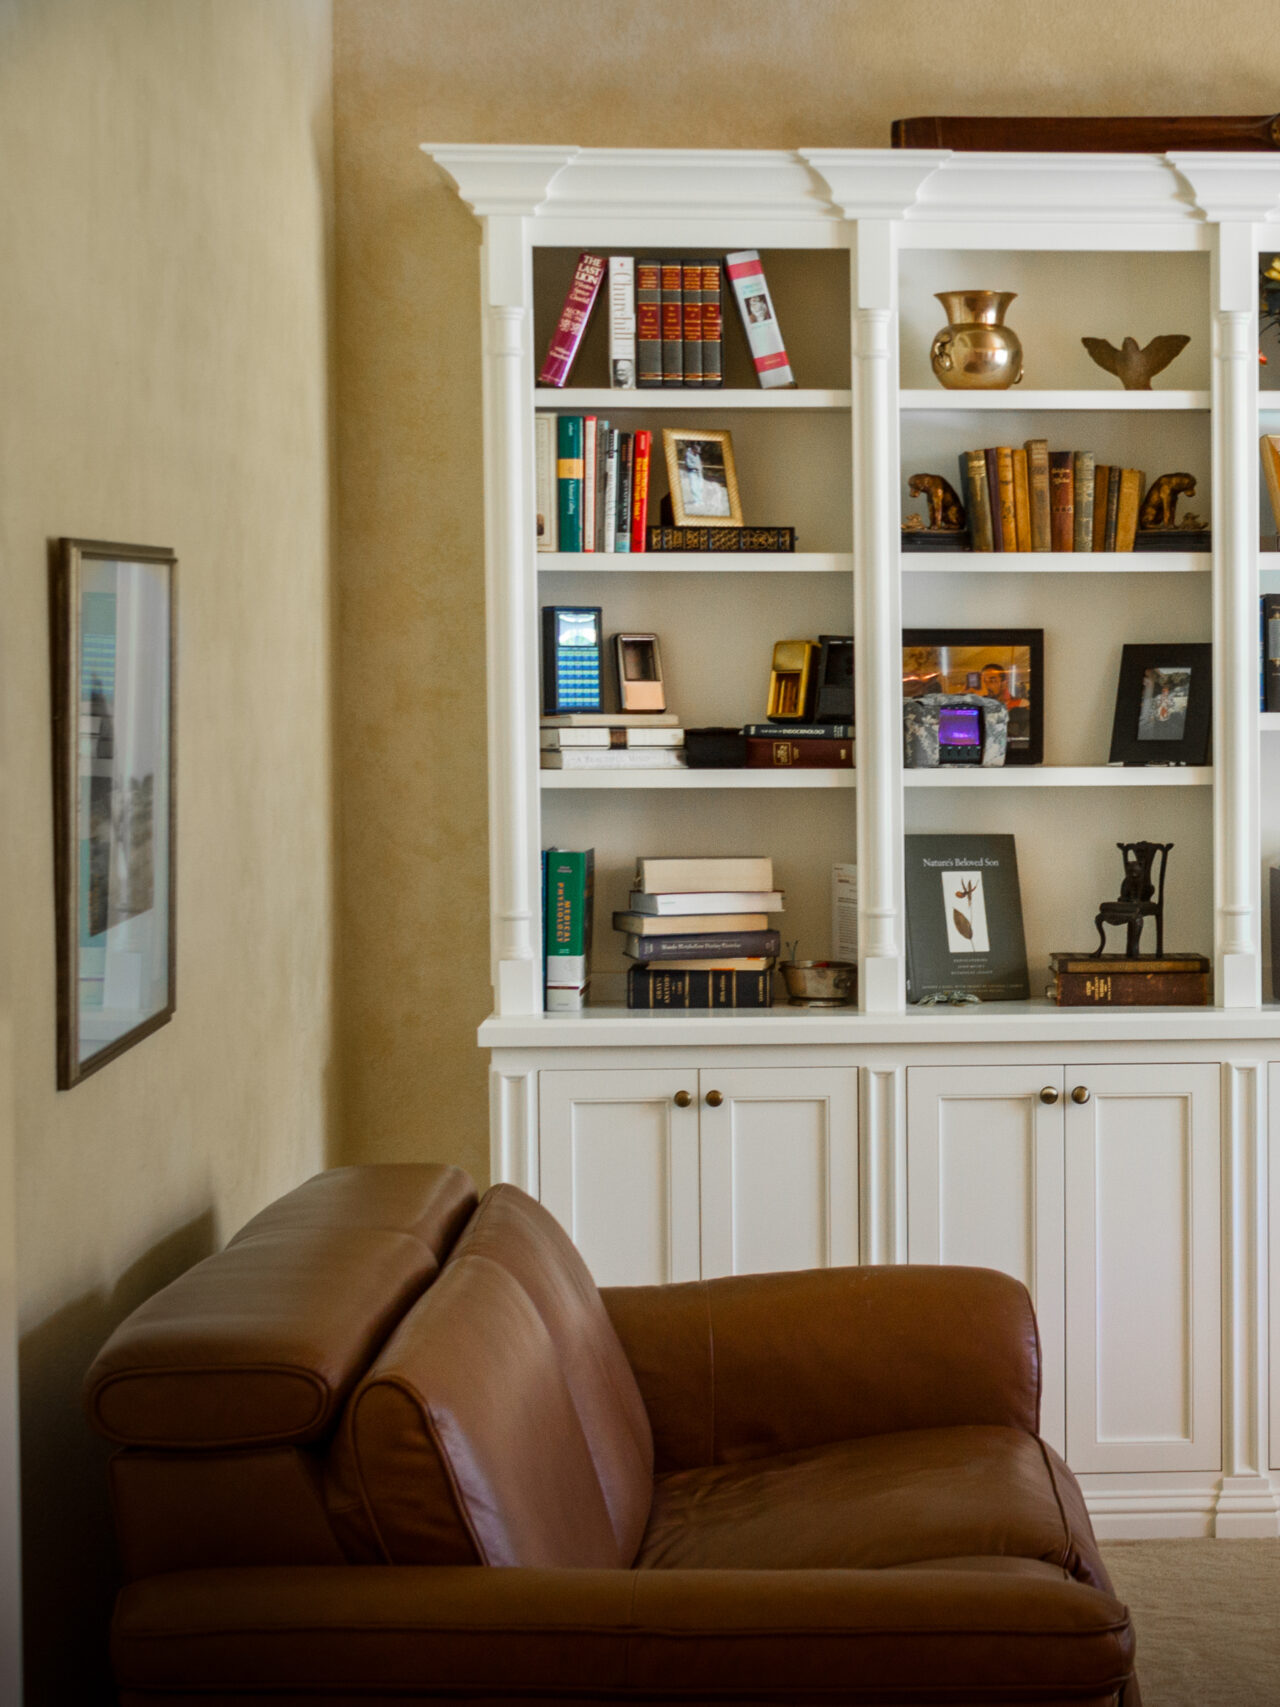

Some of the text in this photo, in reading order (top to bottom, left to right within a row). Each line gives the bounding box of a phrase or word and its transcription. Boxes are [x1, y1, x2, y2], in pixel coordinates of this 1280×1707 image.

[584, 255, 602, 267] THE
[579, 263, 601, 276] LAST
[575, 272, 598, 285] LION
[922, 857, 999, 867] Nature's Beloved Son
[557, 882, 565, 943] PHYSIOLOGY
